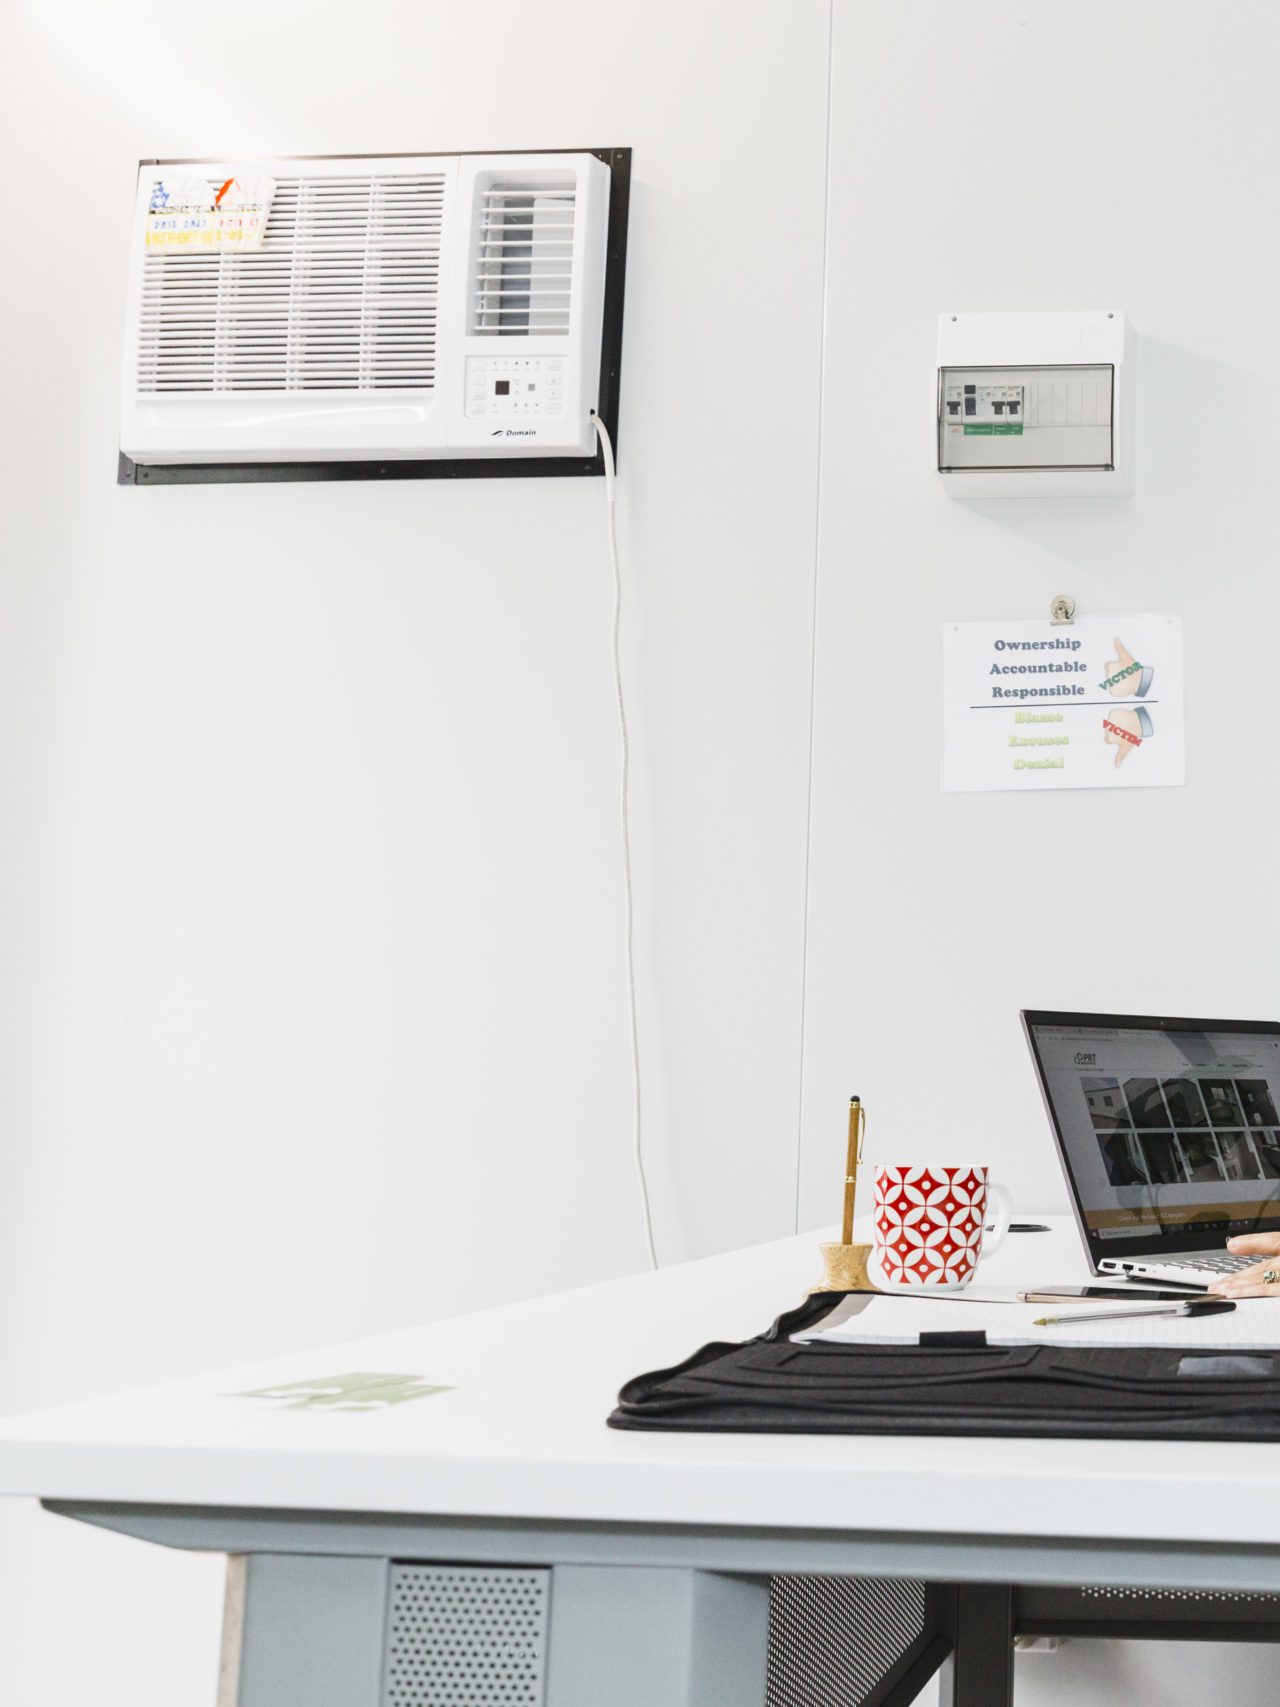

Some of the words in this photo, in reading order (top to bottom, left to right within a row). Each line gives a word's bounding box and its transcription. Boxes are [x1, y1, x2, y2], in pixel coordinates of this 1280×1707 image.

[506, 429, 537, 437] Domain
[994, 638, 1081, 652] Ownership
[989, 661, 1087, 675] Accountable
[1098, 661, 1144, 691] VICTOR
[992, 684, 1085, 699] Responsible
[1102, 719, 1143, 748] VICTIM
[1013, 757, 1065, 770] Denial
